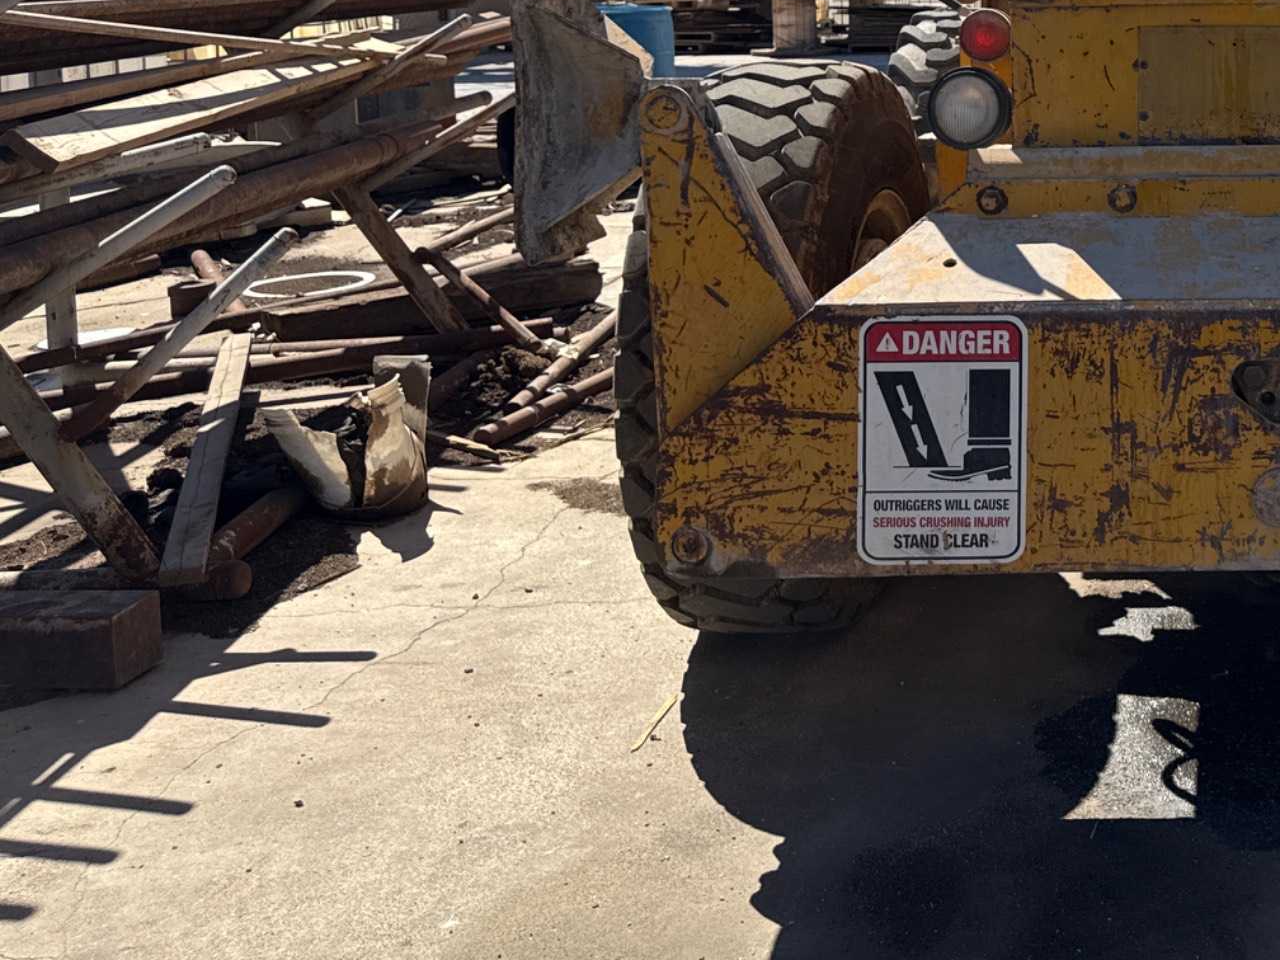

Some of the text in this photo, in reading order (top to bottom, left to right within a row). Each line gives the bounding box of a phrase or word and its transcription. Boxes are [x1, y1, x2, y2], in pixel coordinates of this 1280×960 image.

[902, 330, 1011, 355] DANGER
[873, 498, 1010, 512] OUTRIGGERS WILL CAUSE
[872, 516, 1010, 528] SERIOUS CRUSHING INJURY
[893, 533, 989, 549] STAND CLEAR
